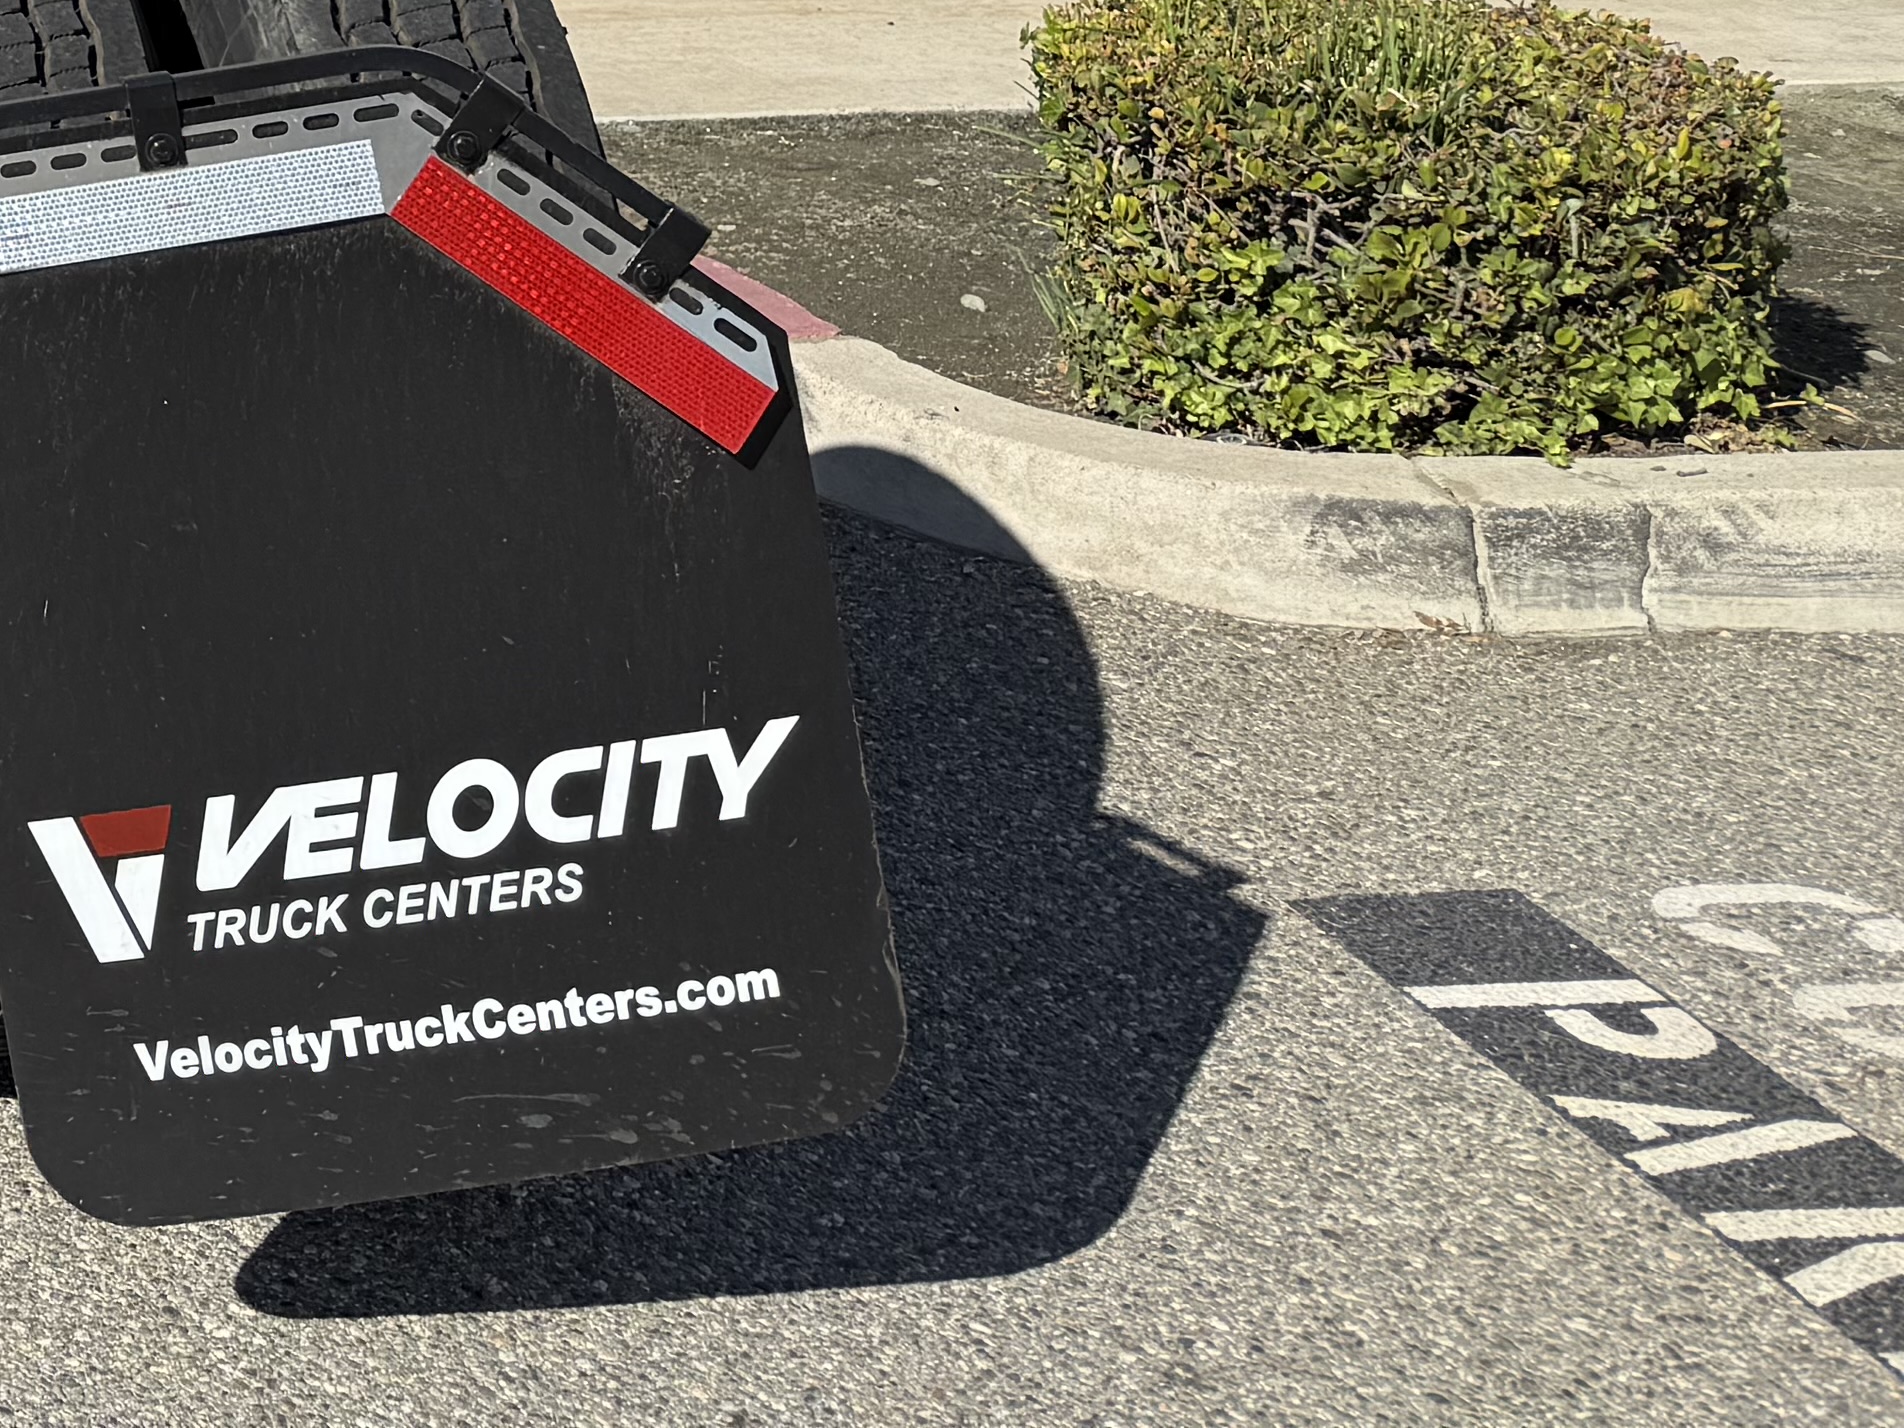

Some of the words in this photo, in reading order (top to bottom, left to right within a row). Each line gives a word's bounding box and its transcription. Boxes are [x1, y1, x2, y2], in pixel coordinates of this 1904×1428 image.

[195, 714, 801, 892] VELOCITY
[186, 893, 350, 952] TRUCK
[362, 862, 584, 929] CENTERS
[132, 967, 781, 1082] VelocityTruckCenters.com
